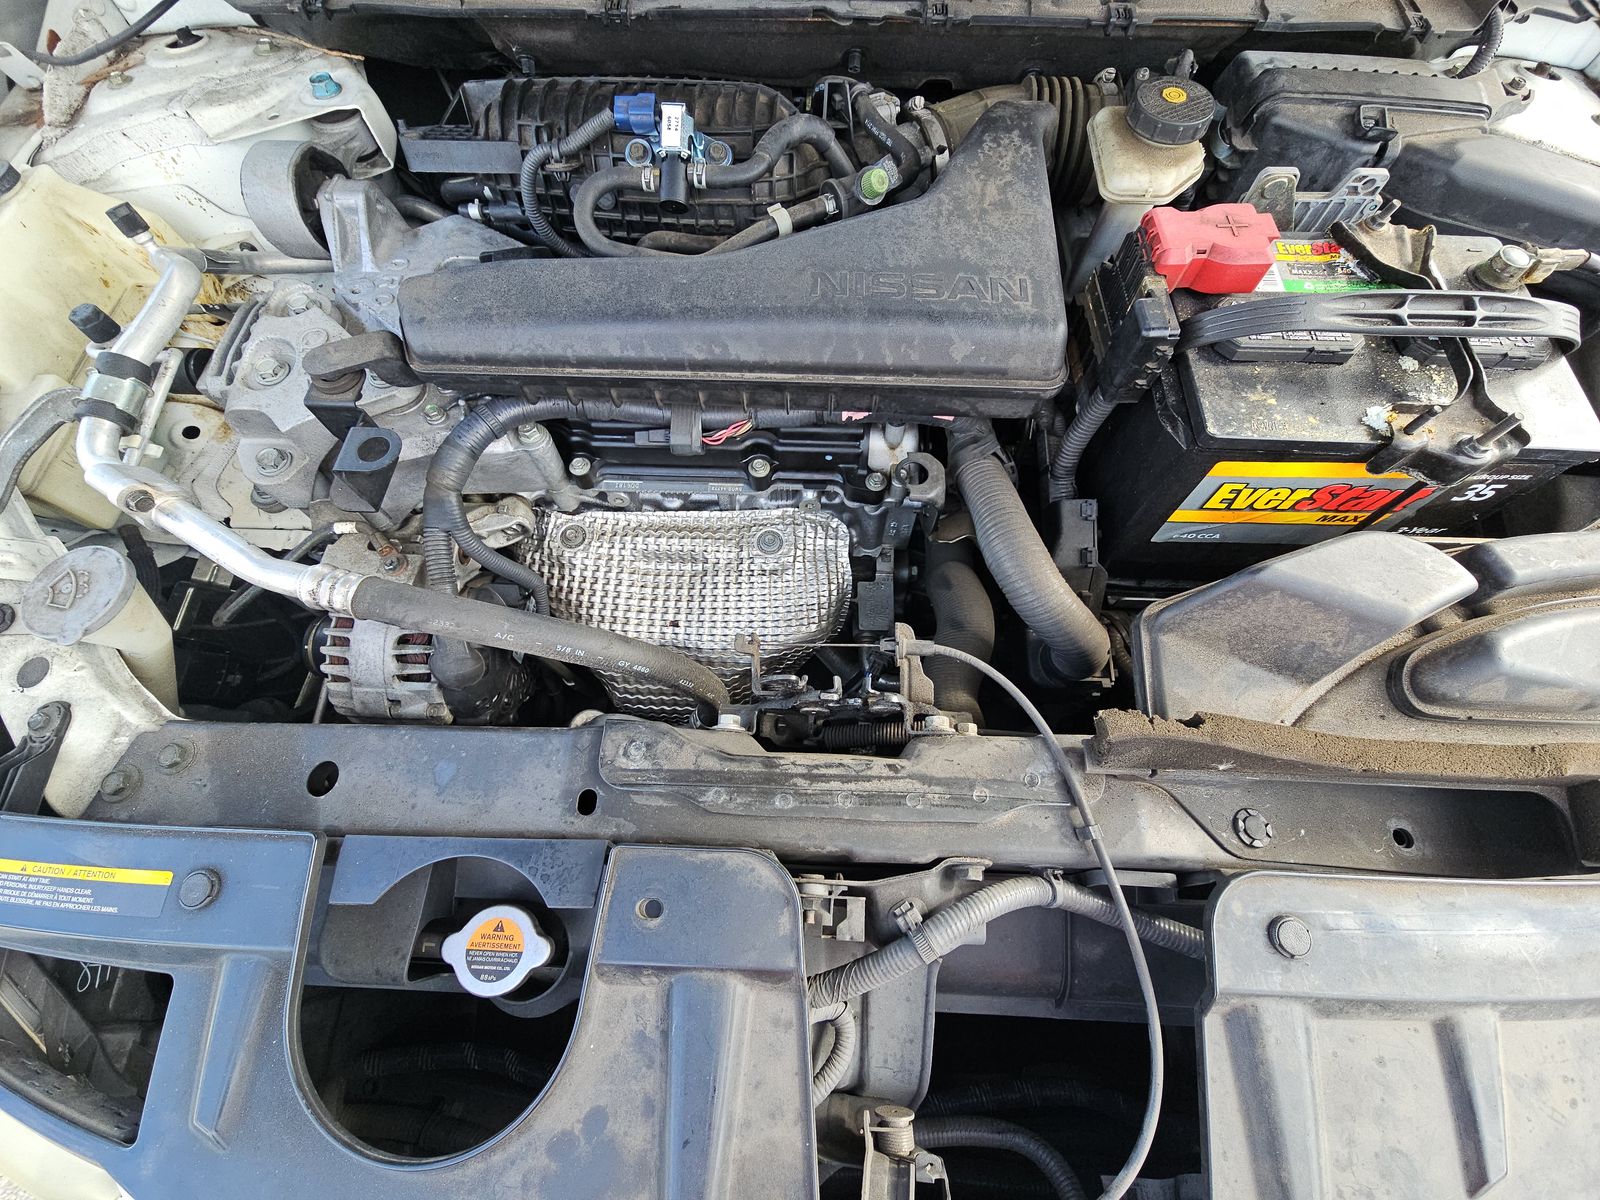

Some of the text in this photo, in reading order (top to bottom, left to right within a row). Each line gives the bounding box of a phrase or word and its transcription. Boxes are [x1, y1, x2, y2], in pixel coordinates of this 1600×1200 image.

[1276, 241, 1342, 255] EverSta
[807, 271, 1032, 304] NISSAN
[1450, 483, 1509, 502] 35
[1316, 514, 1367, 523] MAX
[494, 632, 514, 641] A/C
[574, 649, 586, 657] IN
[618, 660, 631, 668] GY
[32, 865, 65, 876] CAUTION
[73, 869, 116, 880] ATTENTION
[480, 933, 515, 941] WARNING
[470, 941, 521, 950] AVERTISSEMENT
